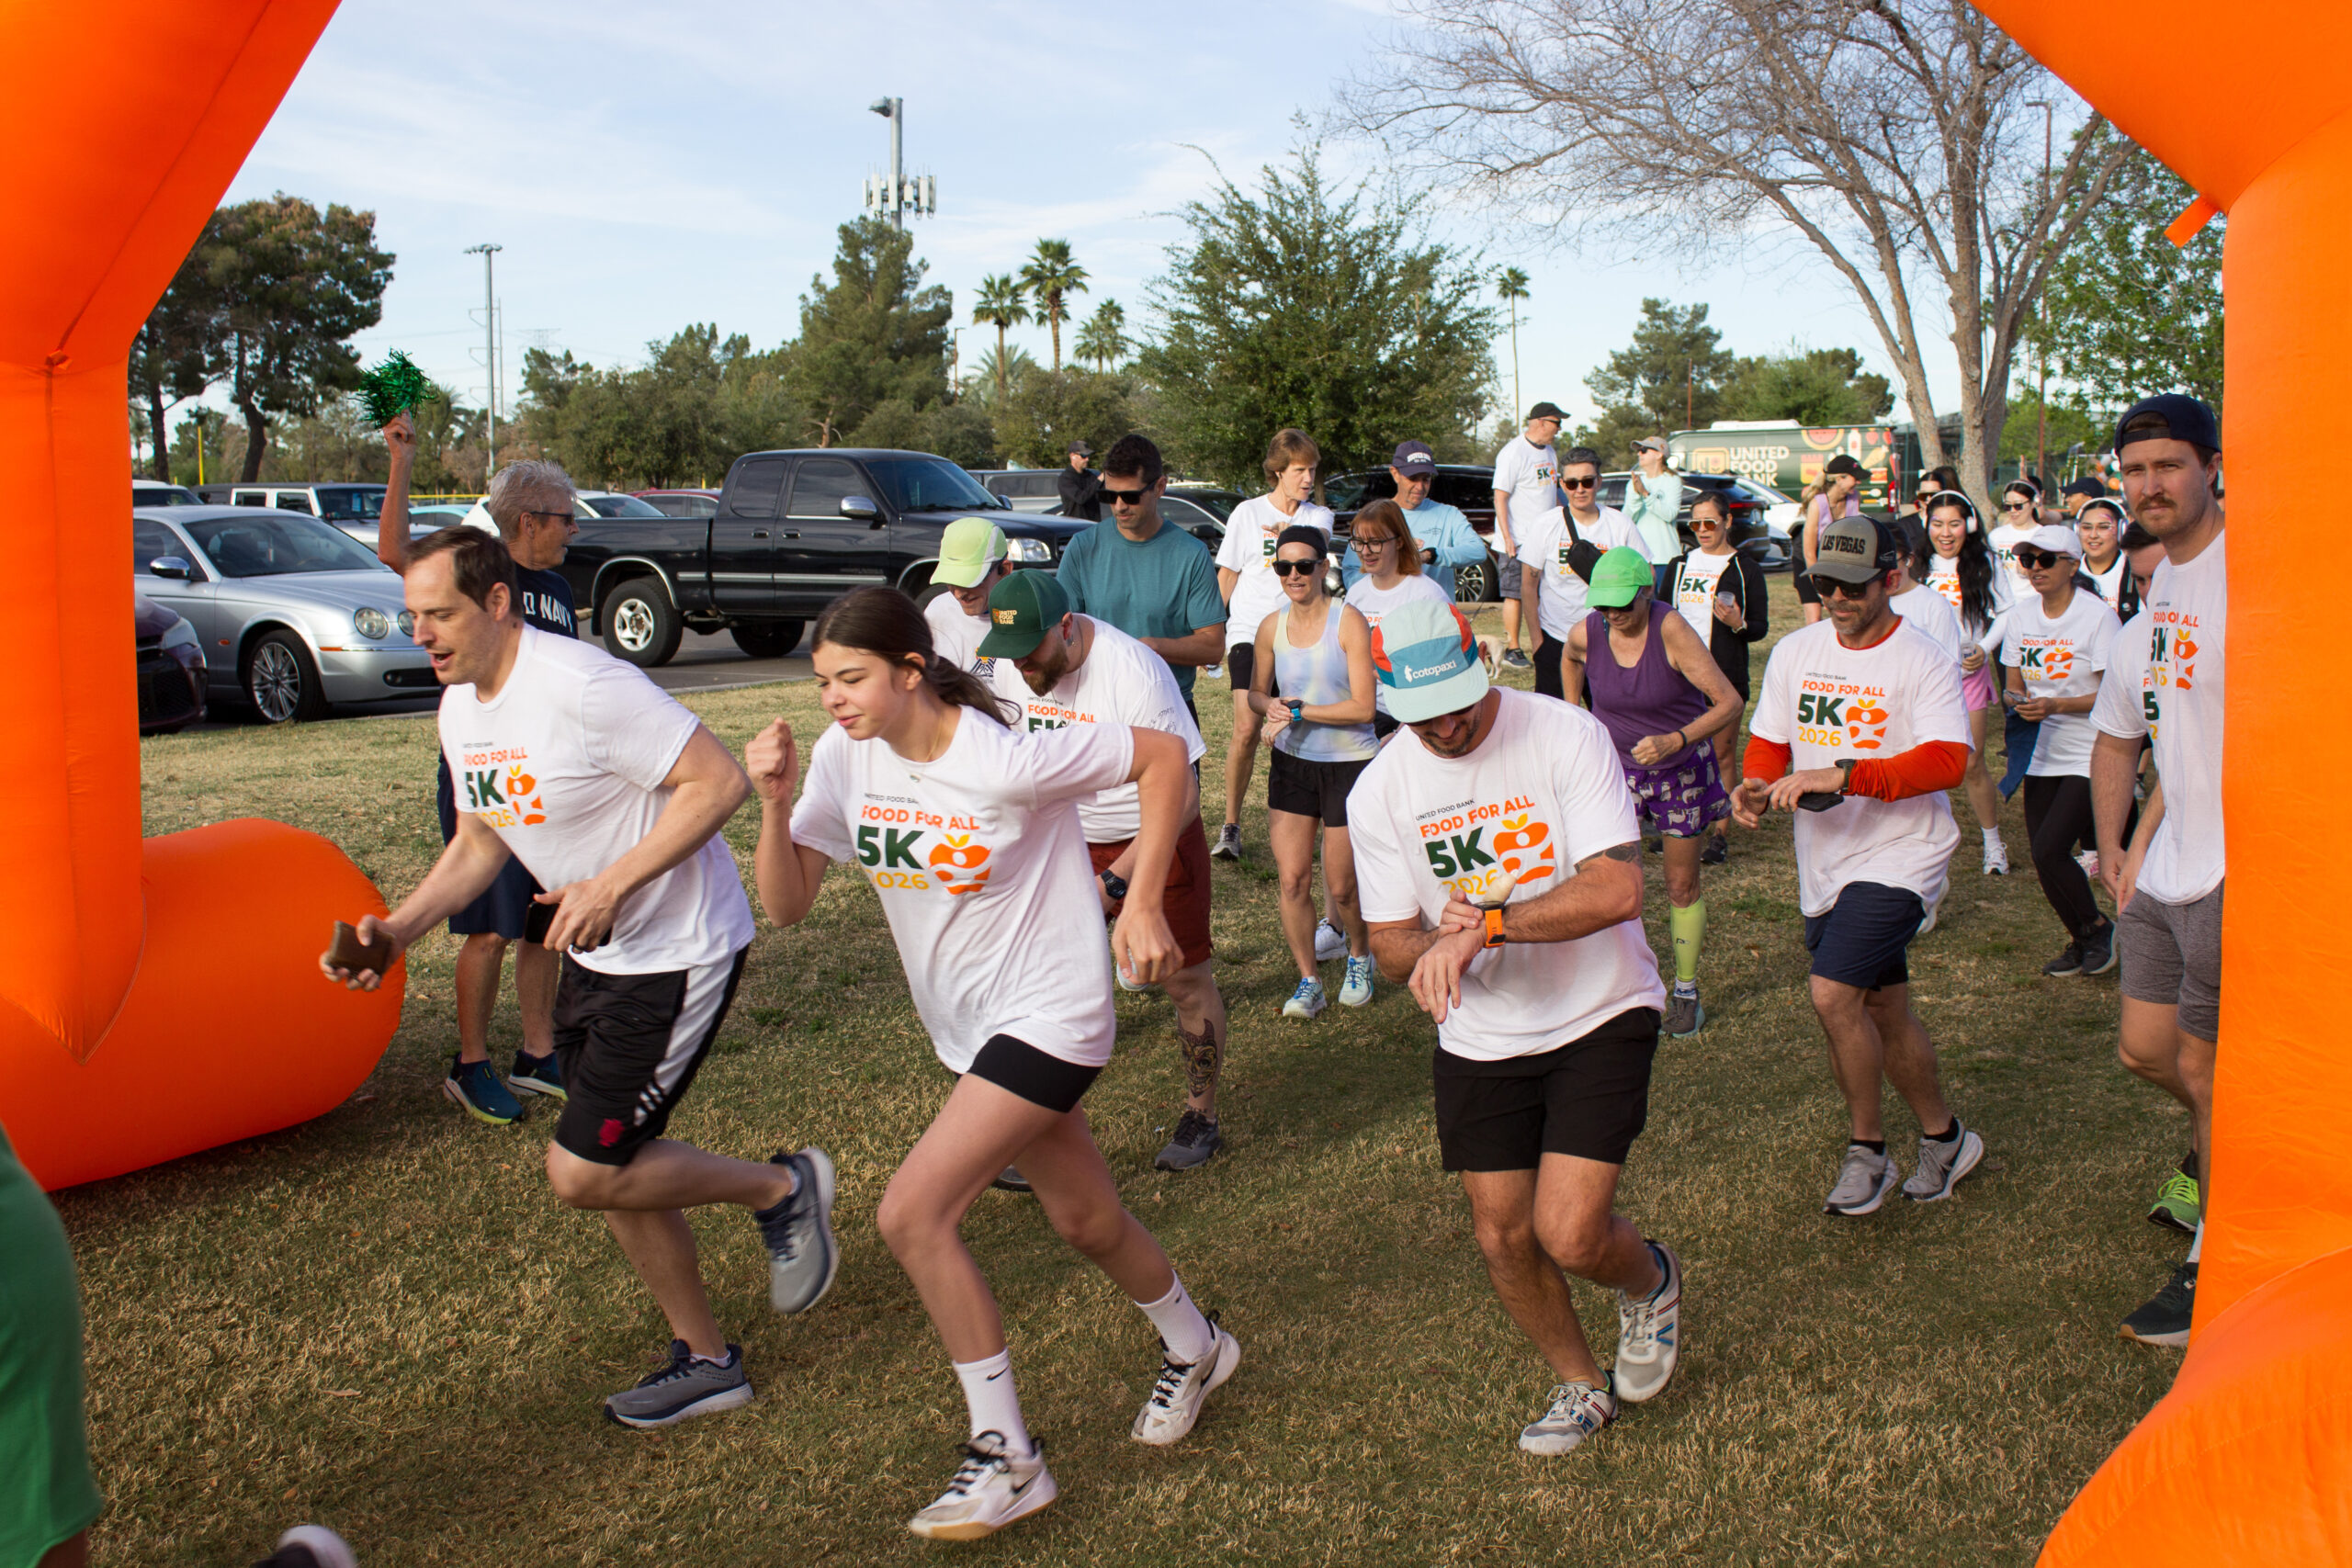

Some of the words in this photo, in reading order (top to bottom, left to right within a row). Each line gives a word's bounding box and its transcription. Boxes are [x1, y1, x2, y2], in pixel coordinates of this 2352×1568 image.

[1729, 446, 1790, 459] UNITED
[1537, 468, 1550, 479] 5K
[1730, 459, 1778, 474] FOOD
[1743, 473, 1778, 488] ANK
[1263, 539, 1276, 556] 5
[1821, 535, 1835, 551] LAS
[1835, 536, 1866, 555] VEGAS
[1681, 578, 1709, 592] 5K
[1680, 593, 1704, 604] 2026
[2181, 614, 2199, 627] ALL
[2022, 638, 2040, 647] OOD
[1412, 660, 1457, 679] cotopaxi
[2021, 669, 2041, 682] 026
[1802, 680, 1835, 693] FOOD
[1838, 684, 1860, 695] FOR
[1862, 686, 1885, 697] ALL
[1028, 704, 1058, 716] FOOD
[1079, 713, 1097, 723] ALL
[1797, 693, 1845, 727] 5K
[2143, 691, 2159, 721] 5
[1797, 725, 1842, 747] 2026
[465, 769, 507, 808] 5K
[475, 808, 516, 828] 026
[861, 805, 910, 823] FOOD
[915, 810, 944, 829] FOR
[948, 816, 980, 830] ALL
[1416, 810, 1436, 821] UNITED
[1437, 805, 1455, 815] FOOD
[1456, 798, 1476, 809] BANK
[1419, 815, 1464, 838] FOOD
[1467, 804, 1500, 824] FOR
[1503, 795, 1535, 815] ALL
[857, 824, 925, 871] 5K
[1425, 826, 1496, 878] 5K
